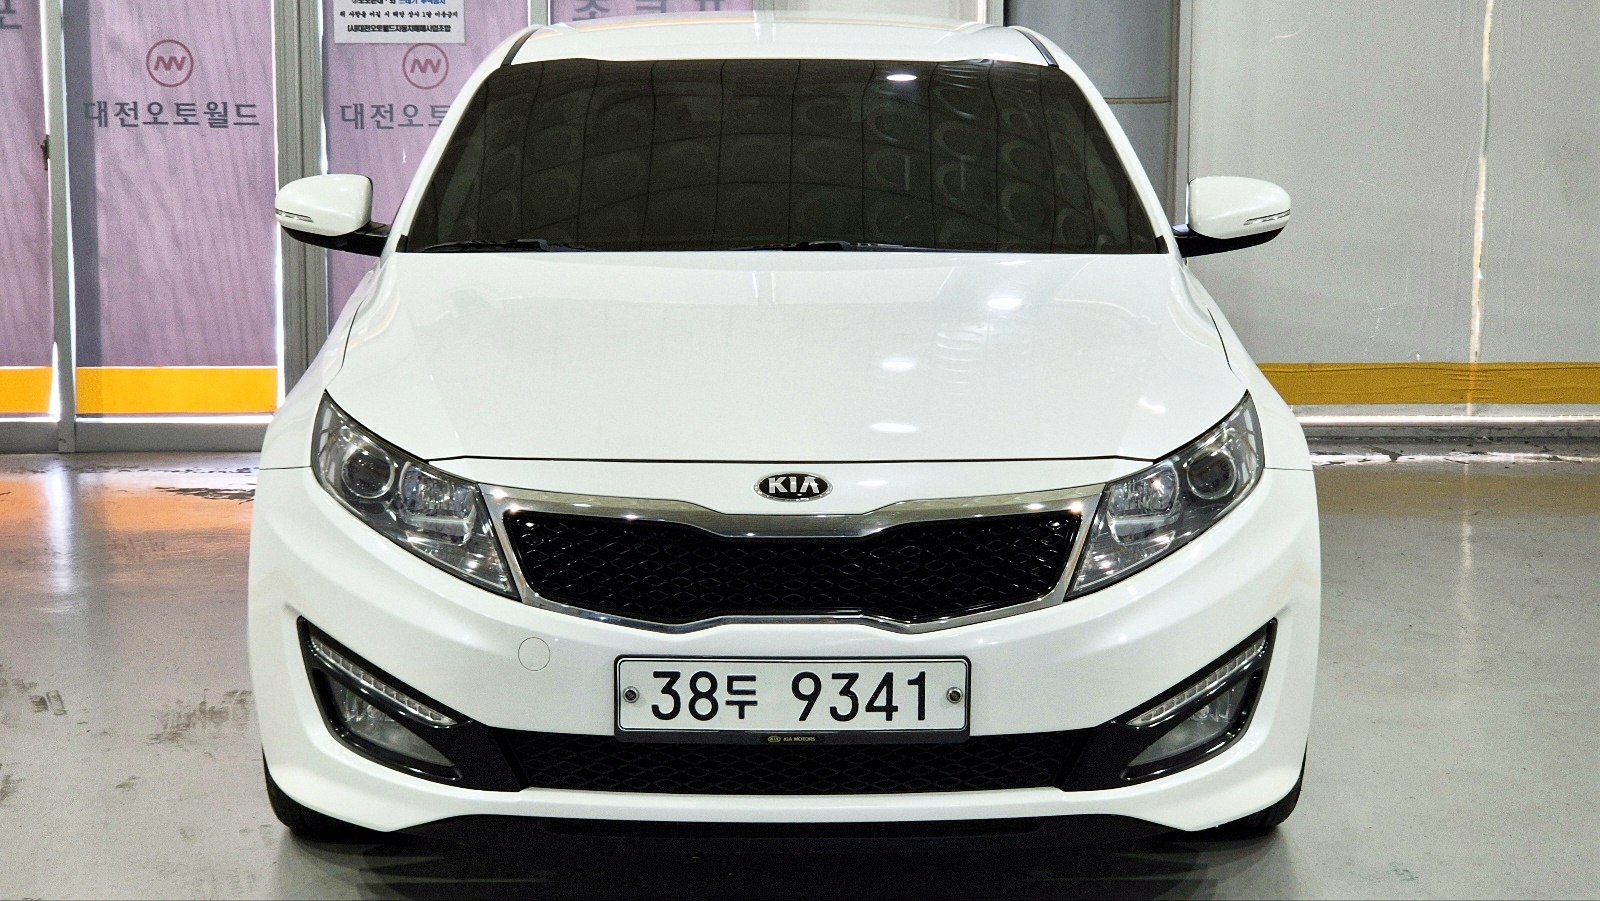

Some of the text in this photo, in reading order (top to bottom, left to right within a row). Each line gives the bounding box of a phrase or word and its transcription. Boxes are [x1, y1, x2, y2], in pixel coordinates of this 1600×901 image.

[83, 100, 260, 129] 대전오토월드
[767, 476, 820, 494] KIA
[651, 670, 926, 722] 38두 9341
